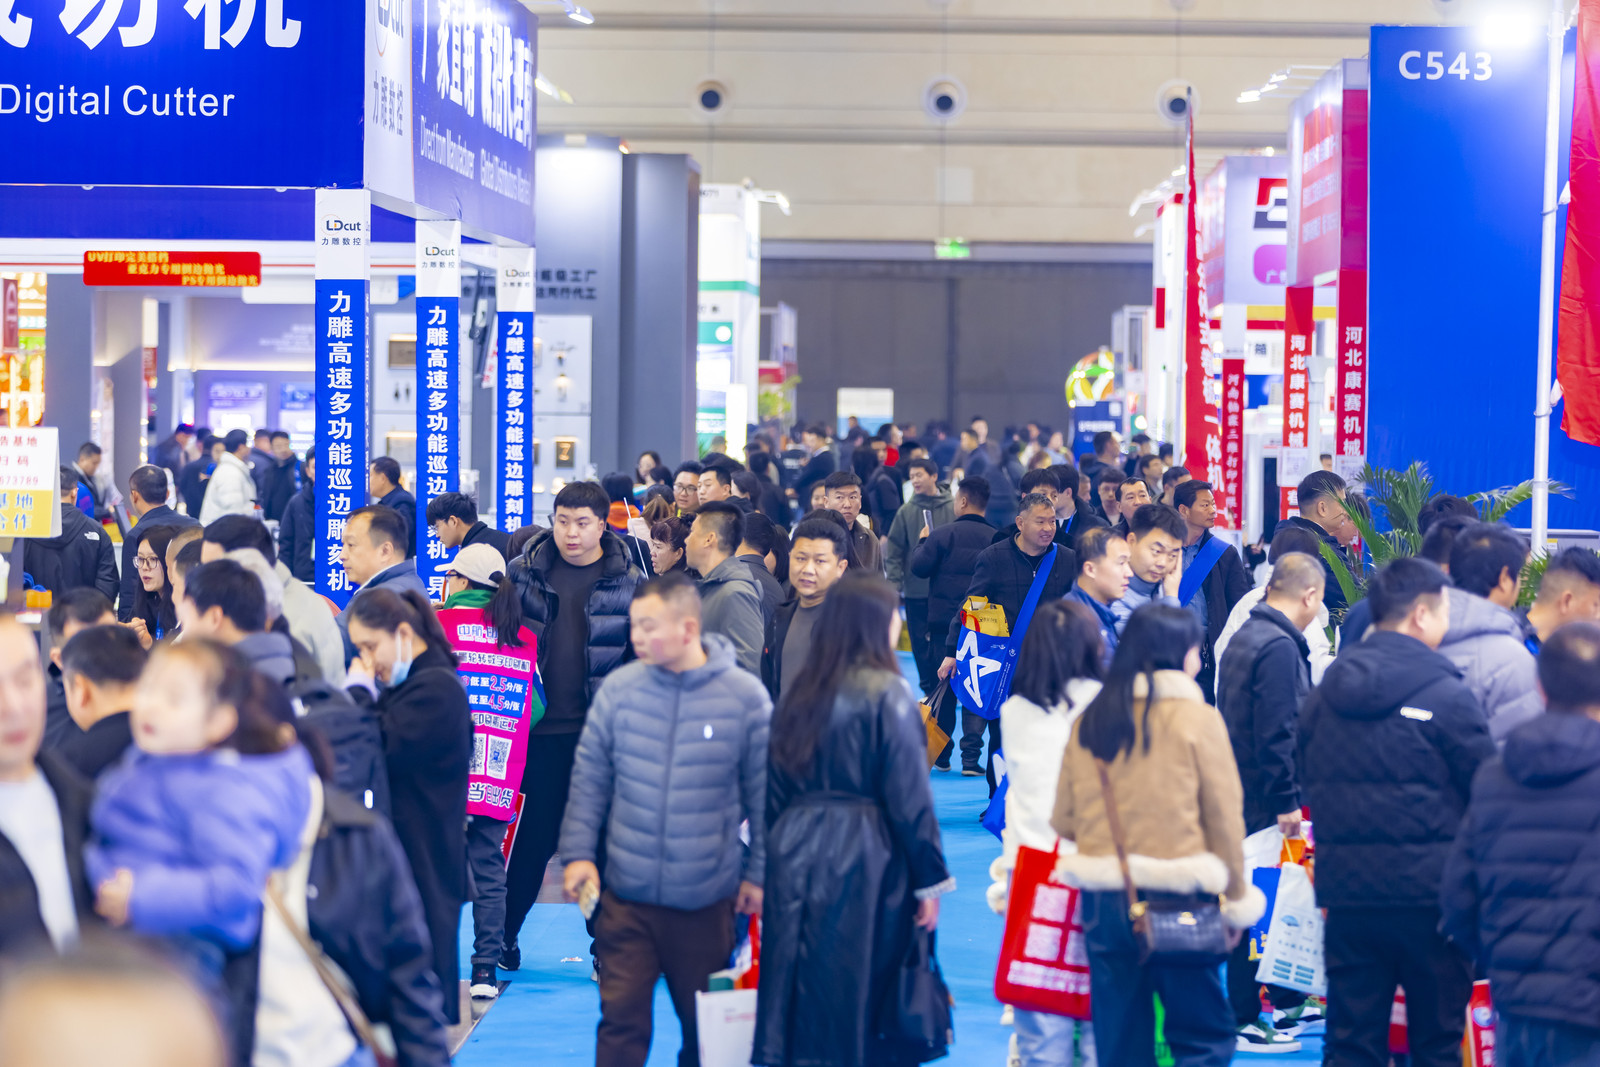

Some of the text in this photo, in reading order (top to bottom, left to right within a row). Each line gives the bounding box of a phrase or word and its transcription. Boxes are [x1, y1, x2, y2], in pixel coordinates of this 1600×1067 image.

[1399, 50, 1493, 81] C543
[0, 84, 235, 123] Digital Cutter
[373, 70, 404, 136] 力雕数控
[321, 237, 362, 246] 力雕数控
[326, 219, 362, 231] LDcut
[425, 246, 455, 256] LDcut
[505, 269, 530, 278] LDcut
[1288, 334, 1306, 448] 河北康赛机械
[1343, 326, 1363, 457] 河北康赛机械
[426, 305, 449, 560] 力雕高速多功能巡边机
[504, 318, 525, 533] 力雕高速多功能巡边雕刻机
